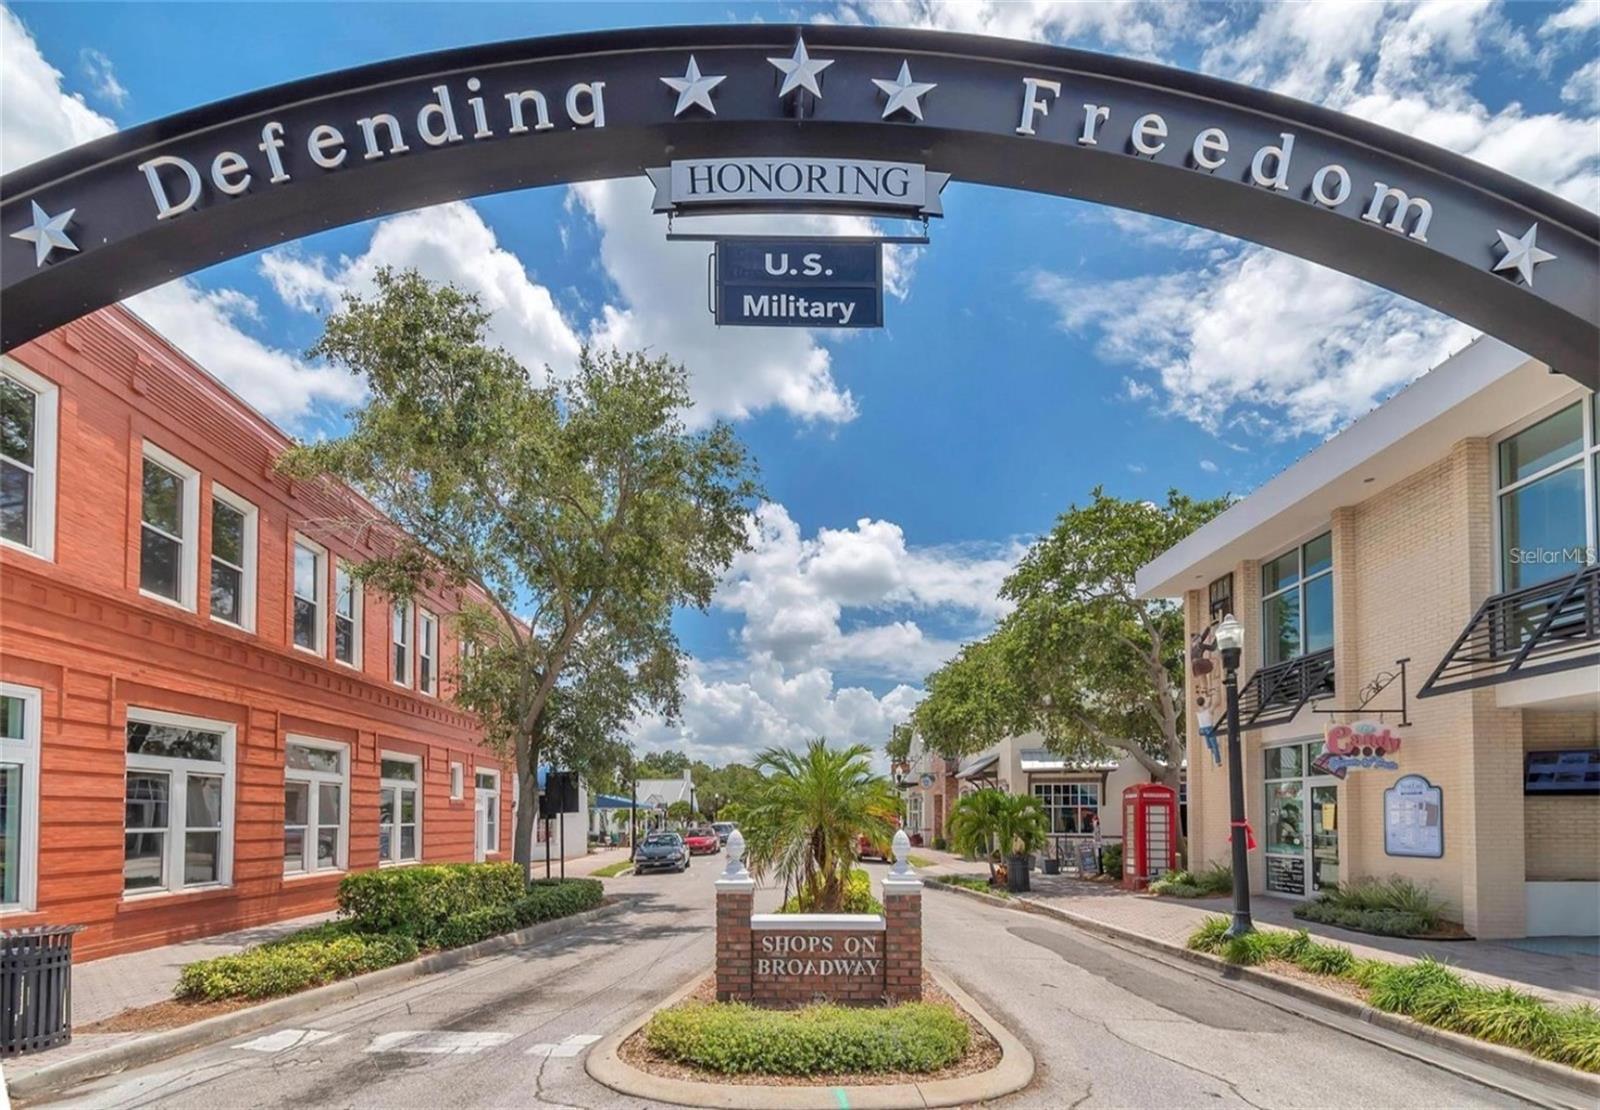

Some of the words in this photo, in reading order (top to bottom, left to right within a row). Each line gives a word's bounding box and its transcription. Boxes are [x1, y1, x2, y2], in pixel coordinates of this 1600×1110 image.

[1016, 77, 1434, 243] Freedom
[687, 163, 912, 198] HONORING
[764, 253, 834, 276] U.S.
[743, 294, 856, 324] Military
[761, 935, 833, 953] SHOPS
[844, 936, 877, 953] ON
[758, 958, 880, 976] BROADWAY
